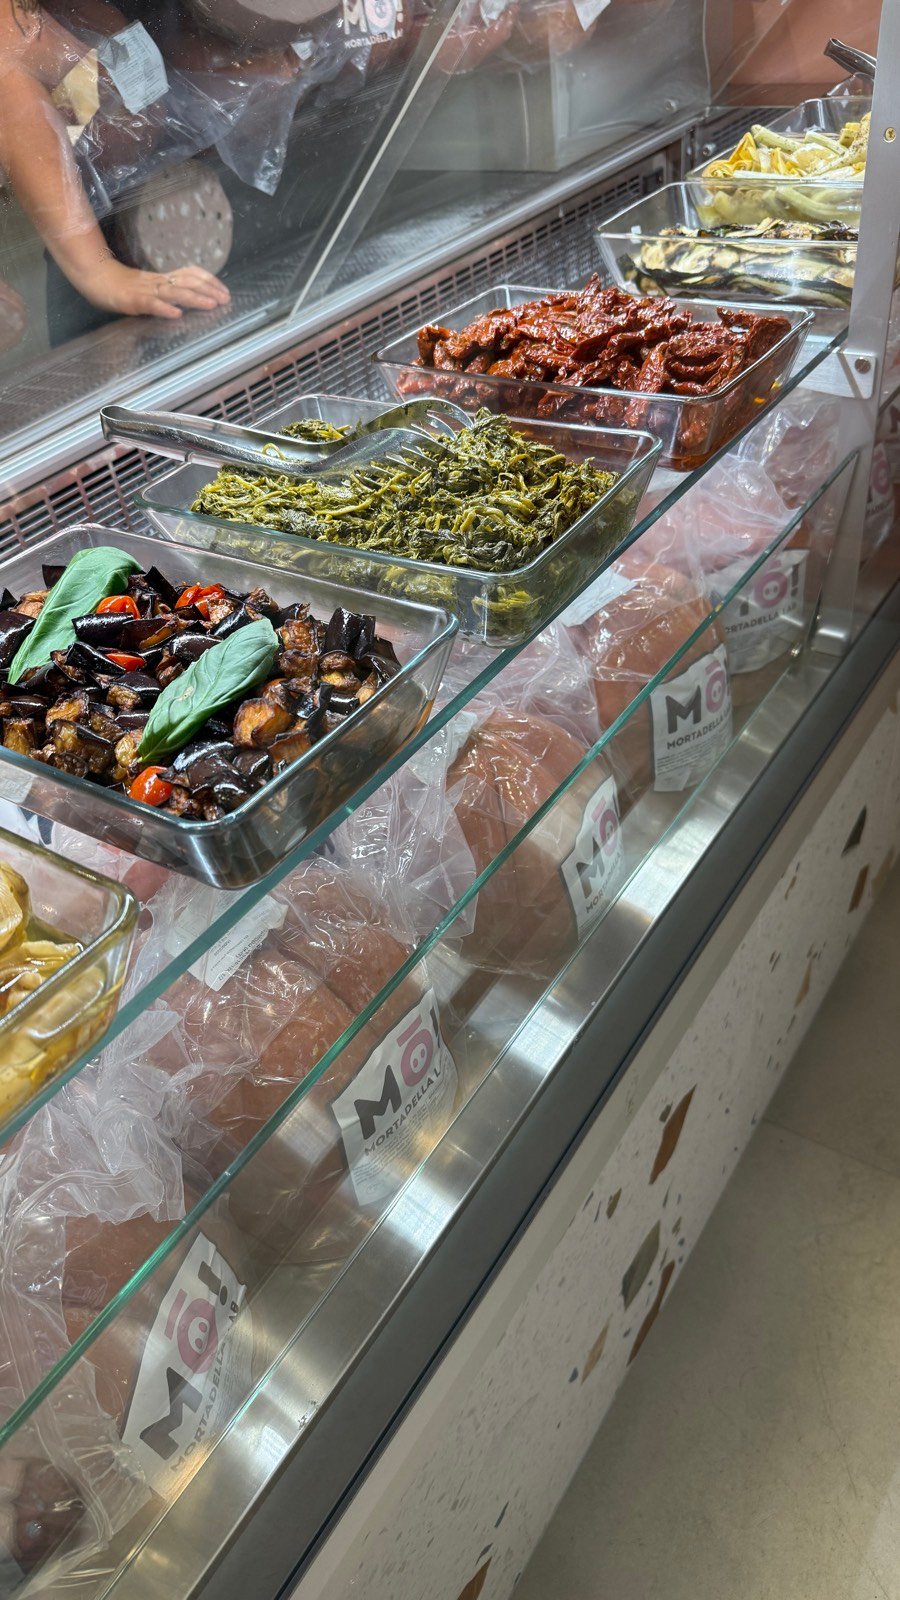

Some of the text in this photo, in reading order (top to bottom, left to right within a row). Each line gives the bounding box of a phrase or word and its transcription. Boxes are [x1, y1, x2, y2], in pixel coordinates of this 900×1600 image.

[666, 714, 724, 750] MORTADELLA
[364, 1077, 434, 1158] MORTADELLA
[171, 1340, 227, 1473] MORTADELLA
